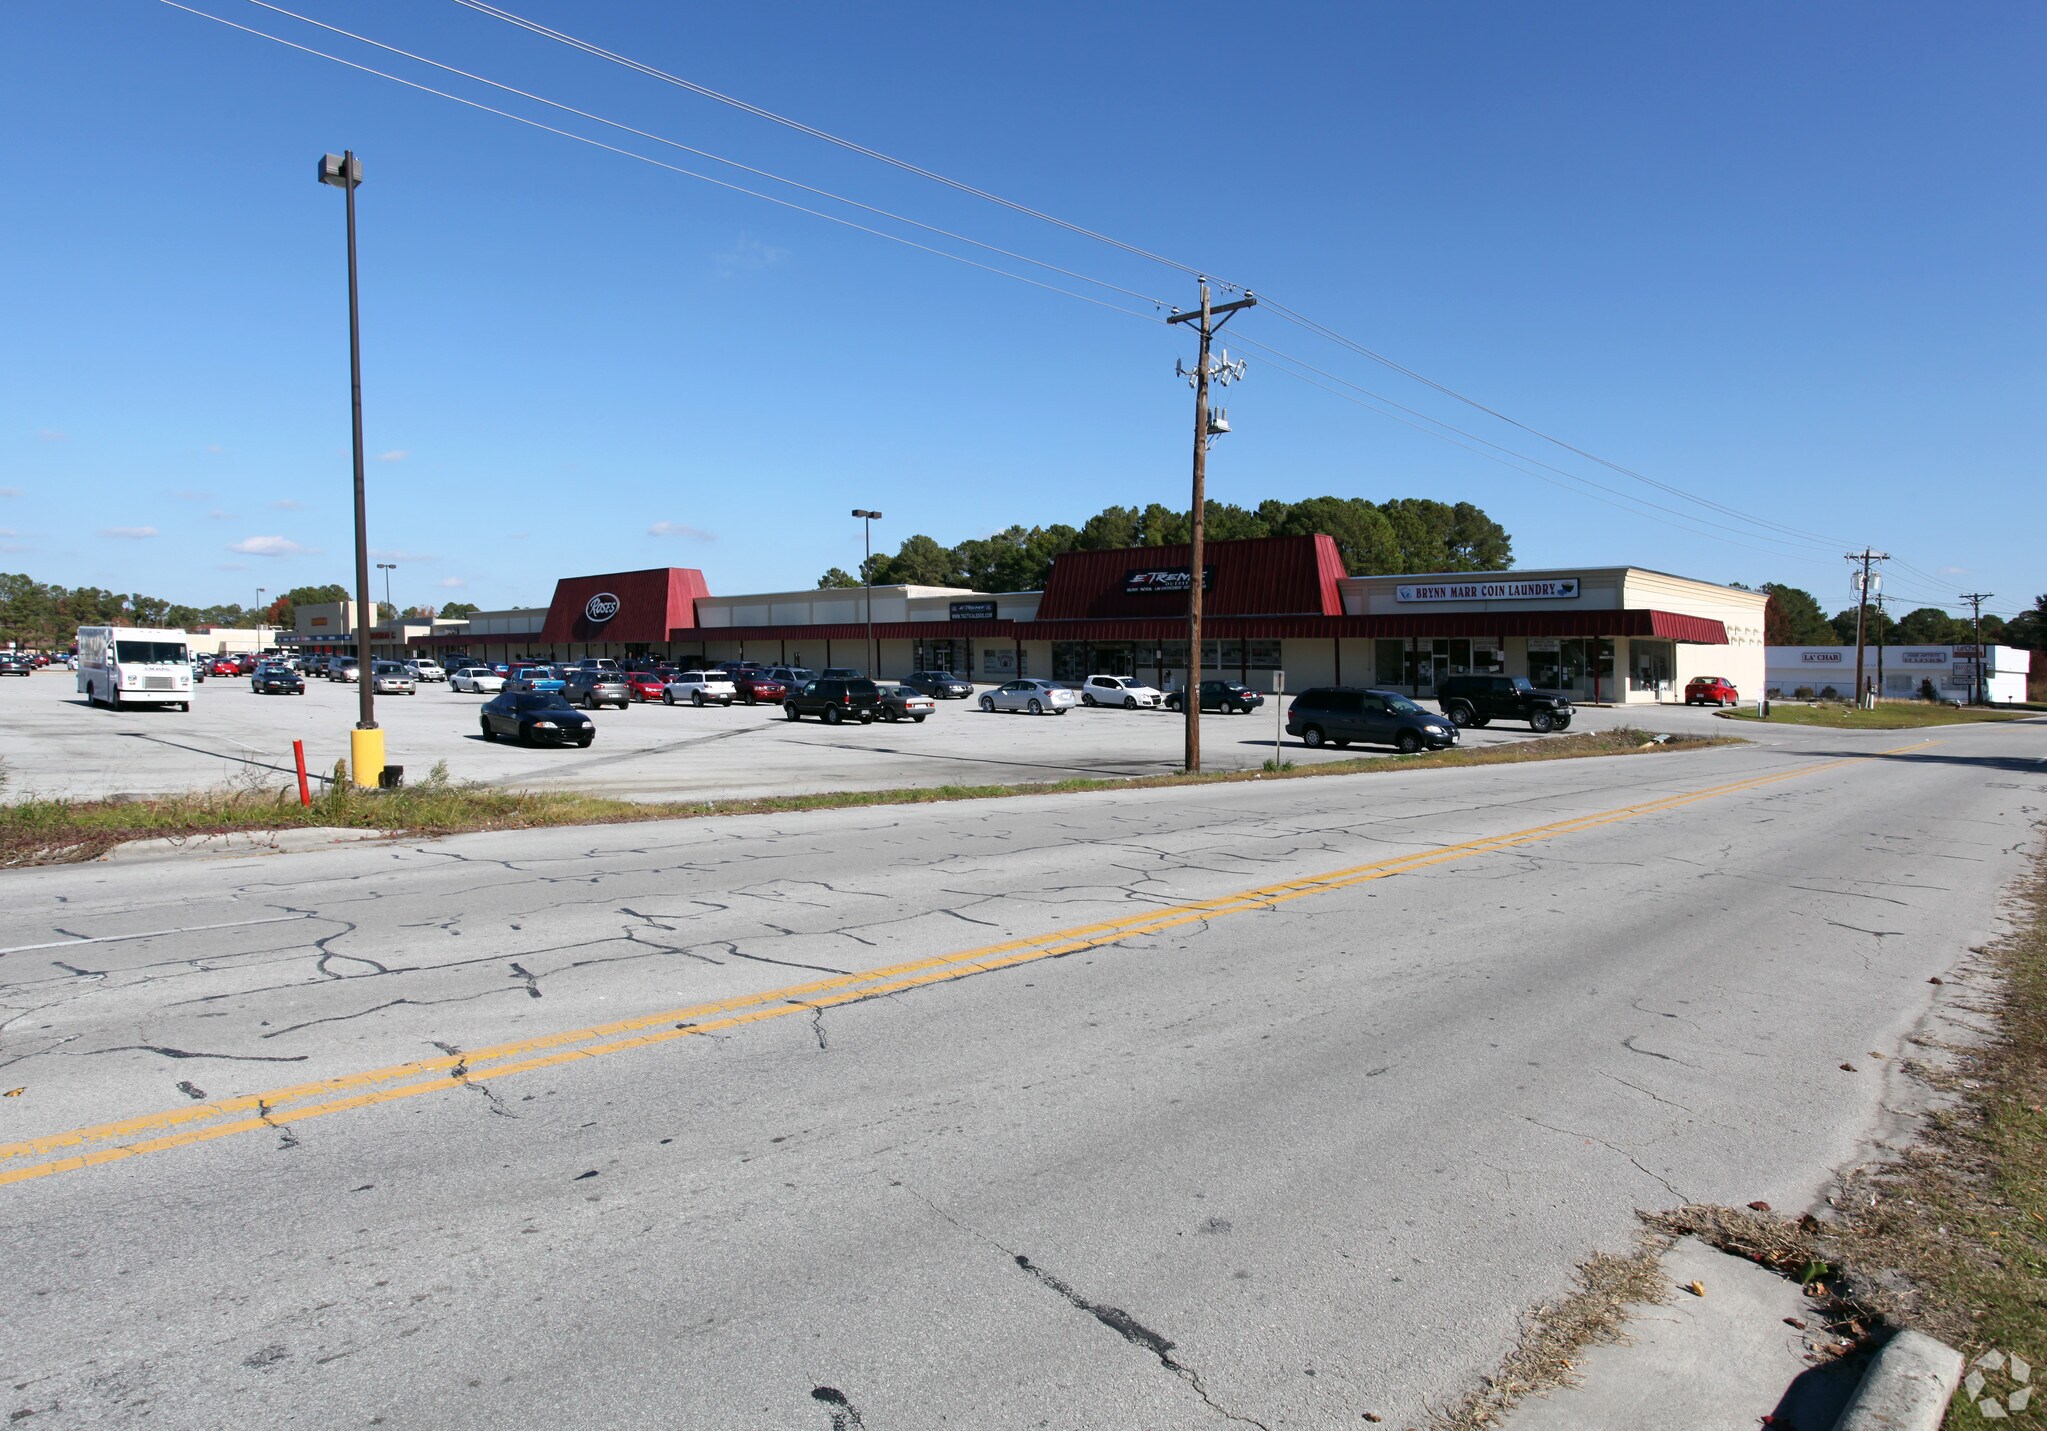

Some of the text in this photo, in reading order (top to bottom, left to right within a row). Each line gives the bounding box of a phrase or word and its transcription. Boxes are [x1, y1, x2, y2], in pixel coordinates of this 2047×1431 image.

[1415, 583, 1556, 599] BRYNN MARR COIN LAUNDRY
